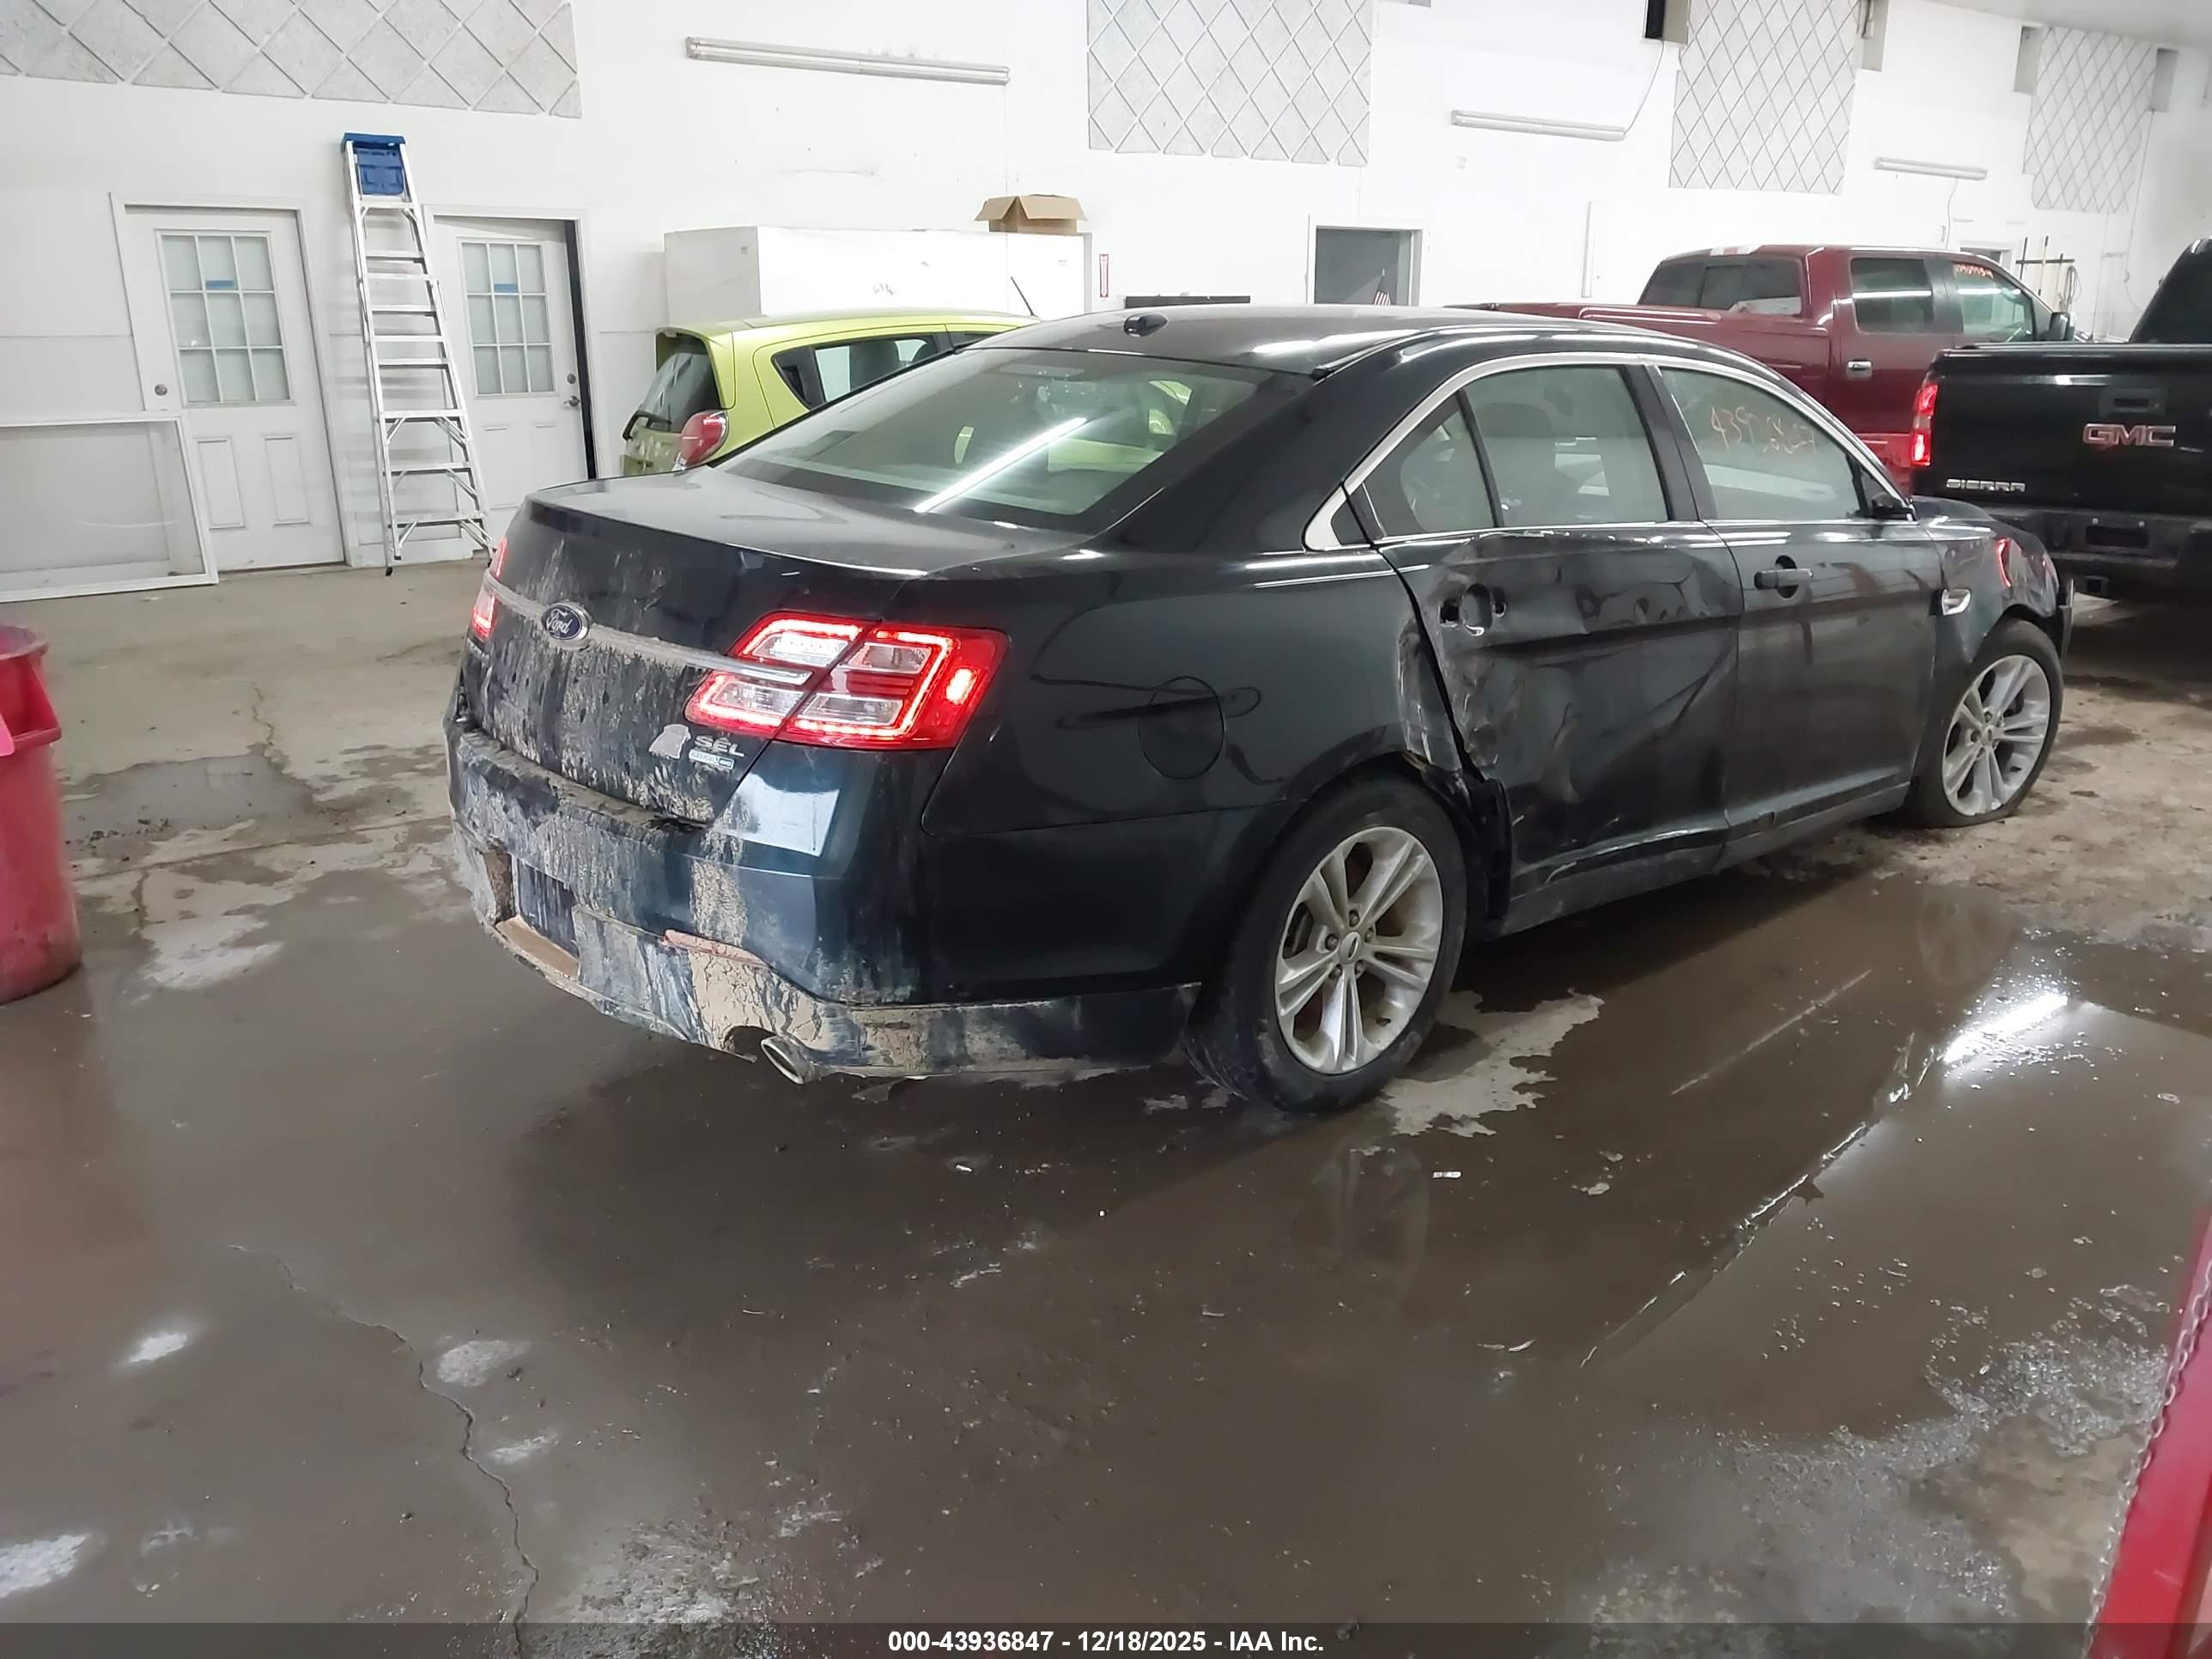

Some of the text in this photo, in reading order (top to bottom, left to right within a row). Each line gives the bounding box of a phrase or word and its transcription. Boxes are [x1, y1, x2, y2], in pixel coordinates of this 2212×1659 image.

[2082, 423, 2177, 447] GMC
[1946, 478, 2026, 492] SIERRA
[546, 608, 574, 635] Ford
[694, 734, 745, 757] SEL
